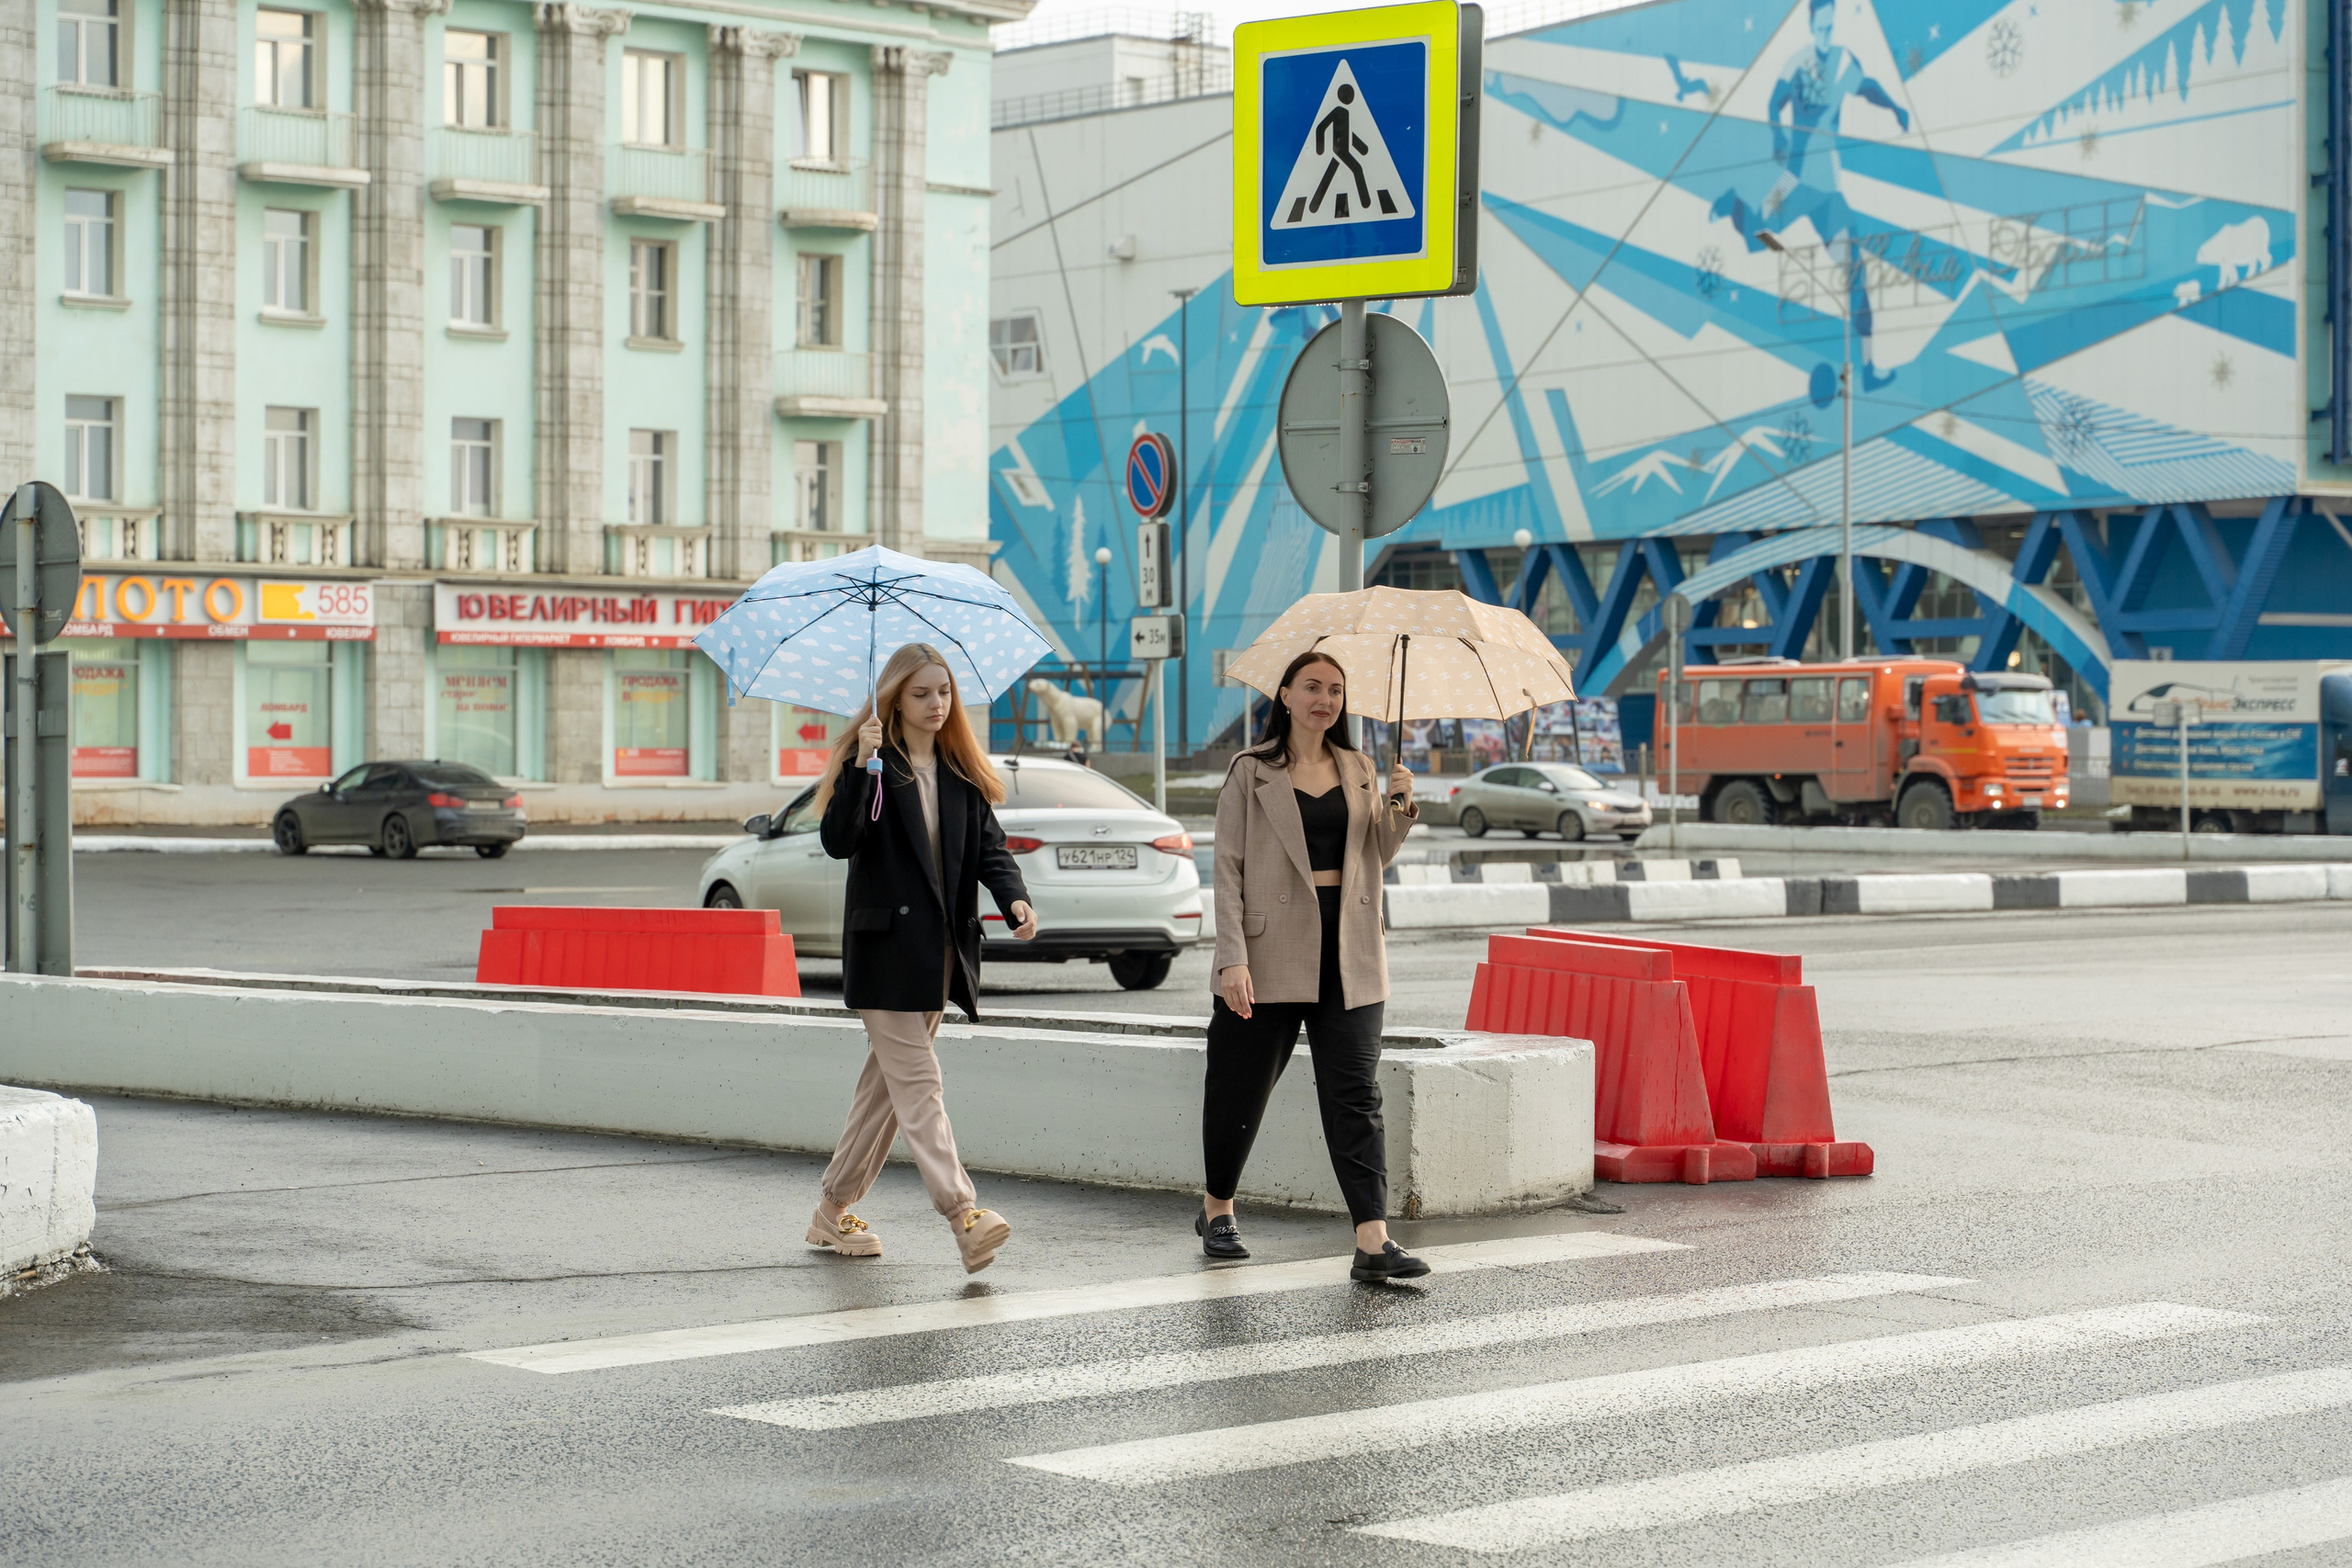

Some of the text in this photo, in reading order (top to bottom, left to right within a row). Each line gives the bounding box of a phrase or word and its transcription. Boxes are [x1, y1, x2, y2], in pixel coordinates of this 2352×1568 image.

[1142, 567, 1155, 583] 30
[74, 575, 243, 623] ЛОТО
[318, 585, 369, 615] 585
[458, 592, 735, 625] ЮВЕЛИРНЫЙ ГИП
[61, 624, 373, 640] ОМБАРД ОБМЕН ЮВЕЛИР
[450, 631, 645, 647] ЮВЕЛИРНЫЙ ГИПЕРМАРКЕТ ЛОМБАРД
[73, 666, 126, 680] ОДАЖА
[622, 675, 679, 687] ПРОДАЖА
[73, 682, 128, 695] РЕДИТ
[260, 702, 308, 713] ЛОМБАРД
[1063, 849, 1135, 863] У621НР 124
